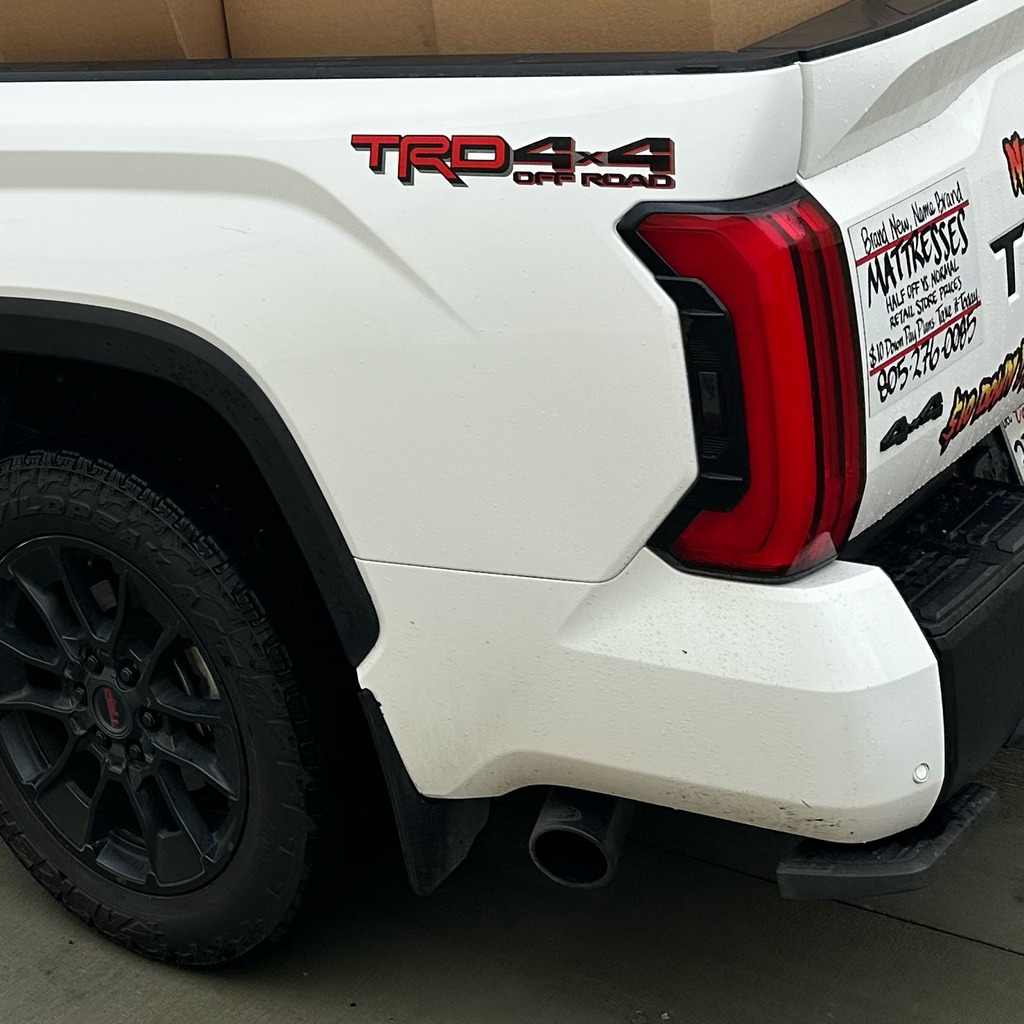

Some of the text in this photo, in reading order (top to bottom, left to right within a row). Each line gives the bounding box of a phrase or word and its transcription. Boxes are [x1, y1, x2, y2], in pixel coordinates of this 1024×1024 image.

[351, 134, 676, 189] TRD 4x4
[513, 171, 676, 189] OFF ROAD
[860, 220, 890, 256] Brand
[911, 201, 936, 227] Name
[934, 180, 964, 214] Brand
[868, 206, 969, 309] MATTRESSES
[886, 288, 906, 314] HALF
[906, 280, 920, 299] OFF
[931, 258, 960, 288] NORMAL
[889, 275, 963, 330] RETAIL STORE PRICES
[868, 338, 884, 369] $10
[884, 335, 904, 358] Down
[938, 386, 977, 456] $10
